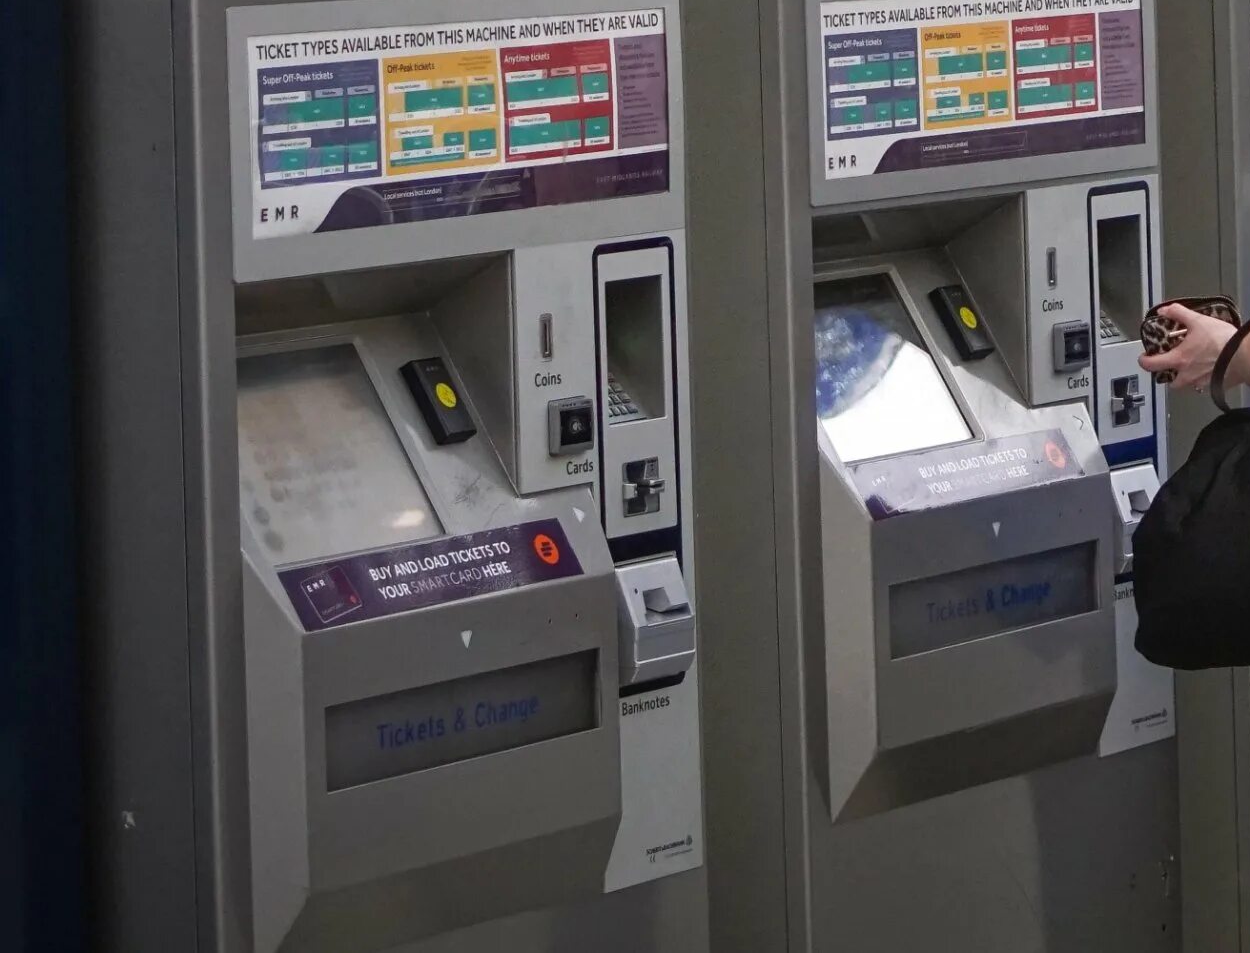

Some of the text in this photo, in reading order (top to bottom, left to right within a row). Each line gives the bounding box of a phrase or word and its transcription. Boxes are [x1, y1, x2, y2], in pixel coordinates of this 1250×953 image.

[823, 12, 856, 28] TICKET
[858, 10, 886, 25] TYPES
[888, 6, 935, 23] AVAILABLE
[937, 5, 962, 19] FROM
[963, 3, 983, 16] THIS
[985, 0, 1023, 15] MACHINE
[256, 13, 659, 60] TICKET TYPES AVAILABLE FROM THIS MACHINE AND WHEN THEY ARE VALID
[387, 62, 435, 74] Off-Peak tickets
[504, 53, 530, 64] Anytime
[531, 52, 550, 62] tickets
[263, 71, 334, 86] Super Off-Peak tickets
[1042, 299, 1064, 313] Coins
[534, 373, 562, 387] Coins
[1067, 376, 1090, 390] Cards
[566, 459, 594, 476] Cards
[919, 447, 1028, 479] BUY AND LOAD TICKETS TO
[926, 465, 1030, 495] YOUR HERE
[369, 541, 511, 582] BUY AND LOAD TICKETS TO
[378, 561, 512, 600] YOUR SMARTCARD HERE
[926, 581, 1051, 624] Tickets & Change
[621, 694, 671, 717] Banknotes
[377, 695, 540, 750] Tickets & Change
